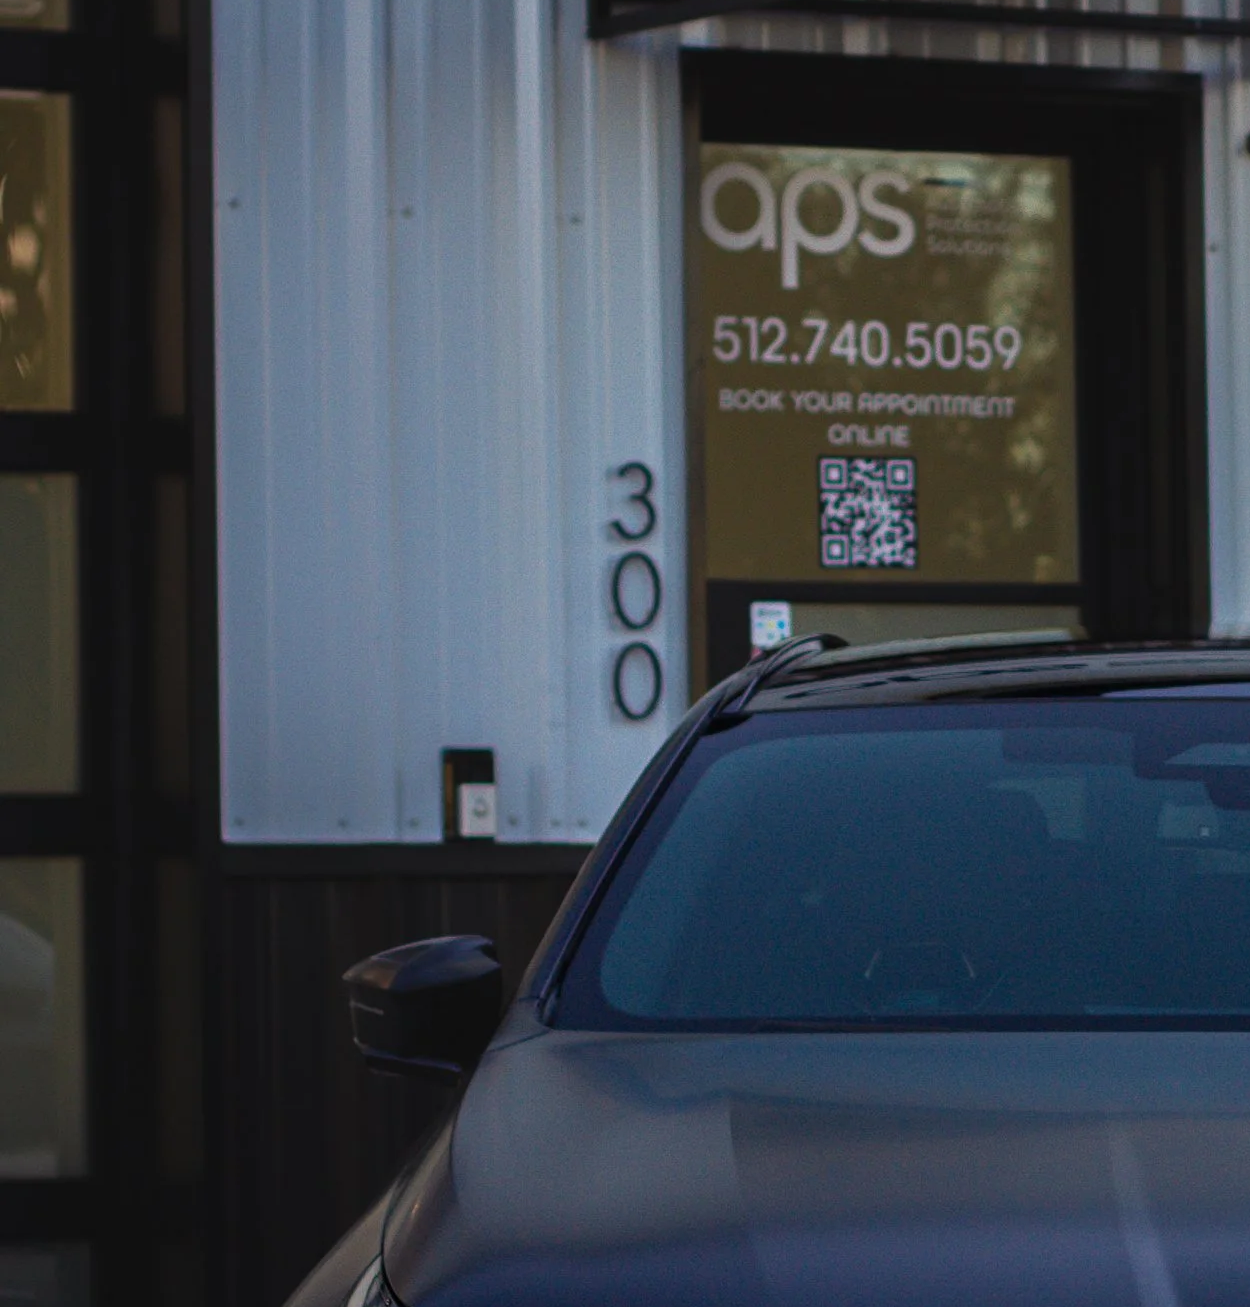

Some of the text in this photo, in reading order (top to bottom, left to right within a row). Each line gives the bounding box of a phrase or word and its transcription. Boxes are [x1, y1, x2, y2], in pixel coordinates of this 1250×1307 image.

[701, 162, 915, 290] aps
[713, 316, 1021, 369] 512.740.5059
[719, 389, 783, 411] BOOK
[791, 391, 850, 413] YOUR
[828, 424, 909, 448] ONLINE
[610, 461, 662, 721] 300
